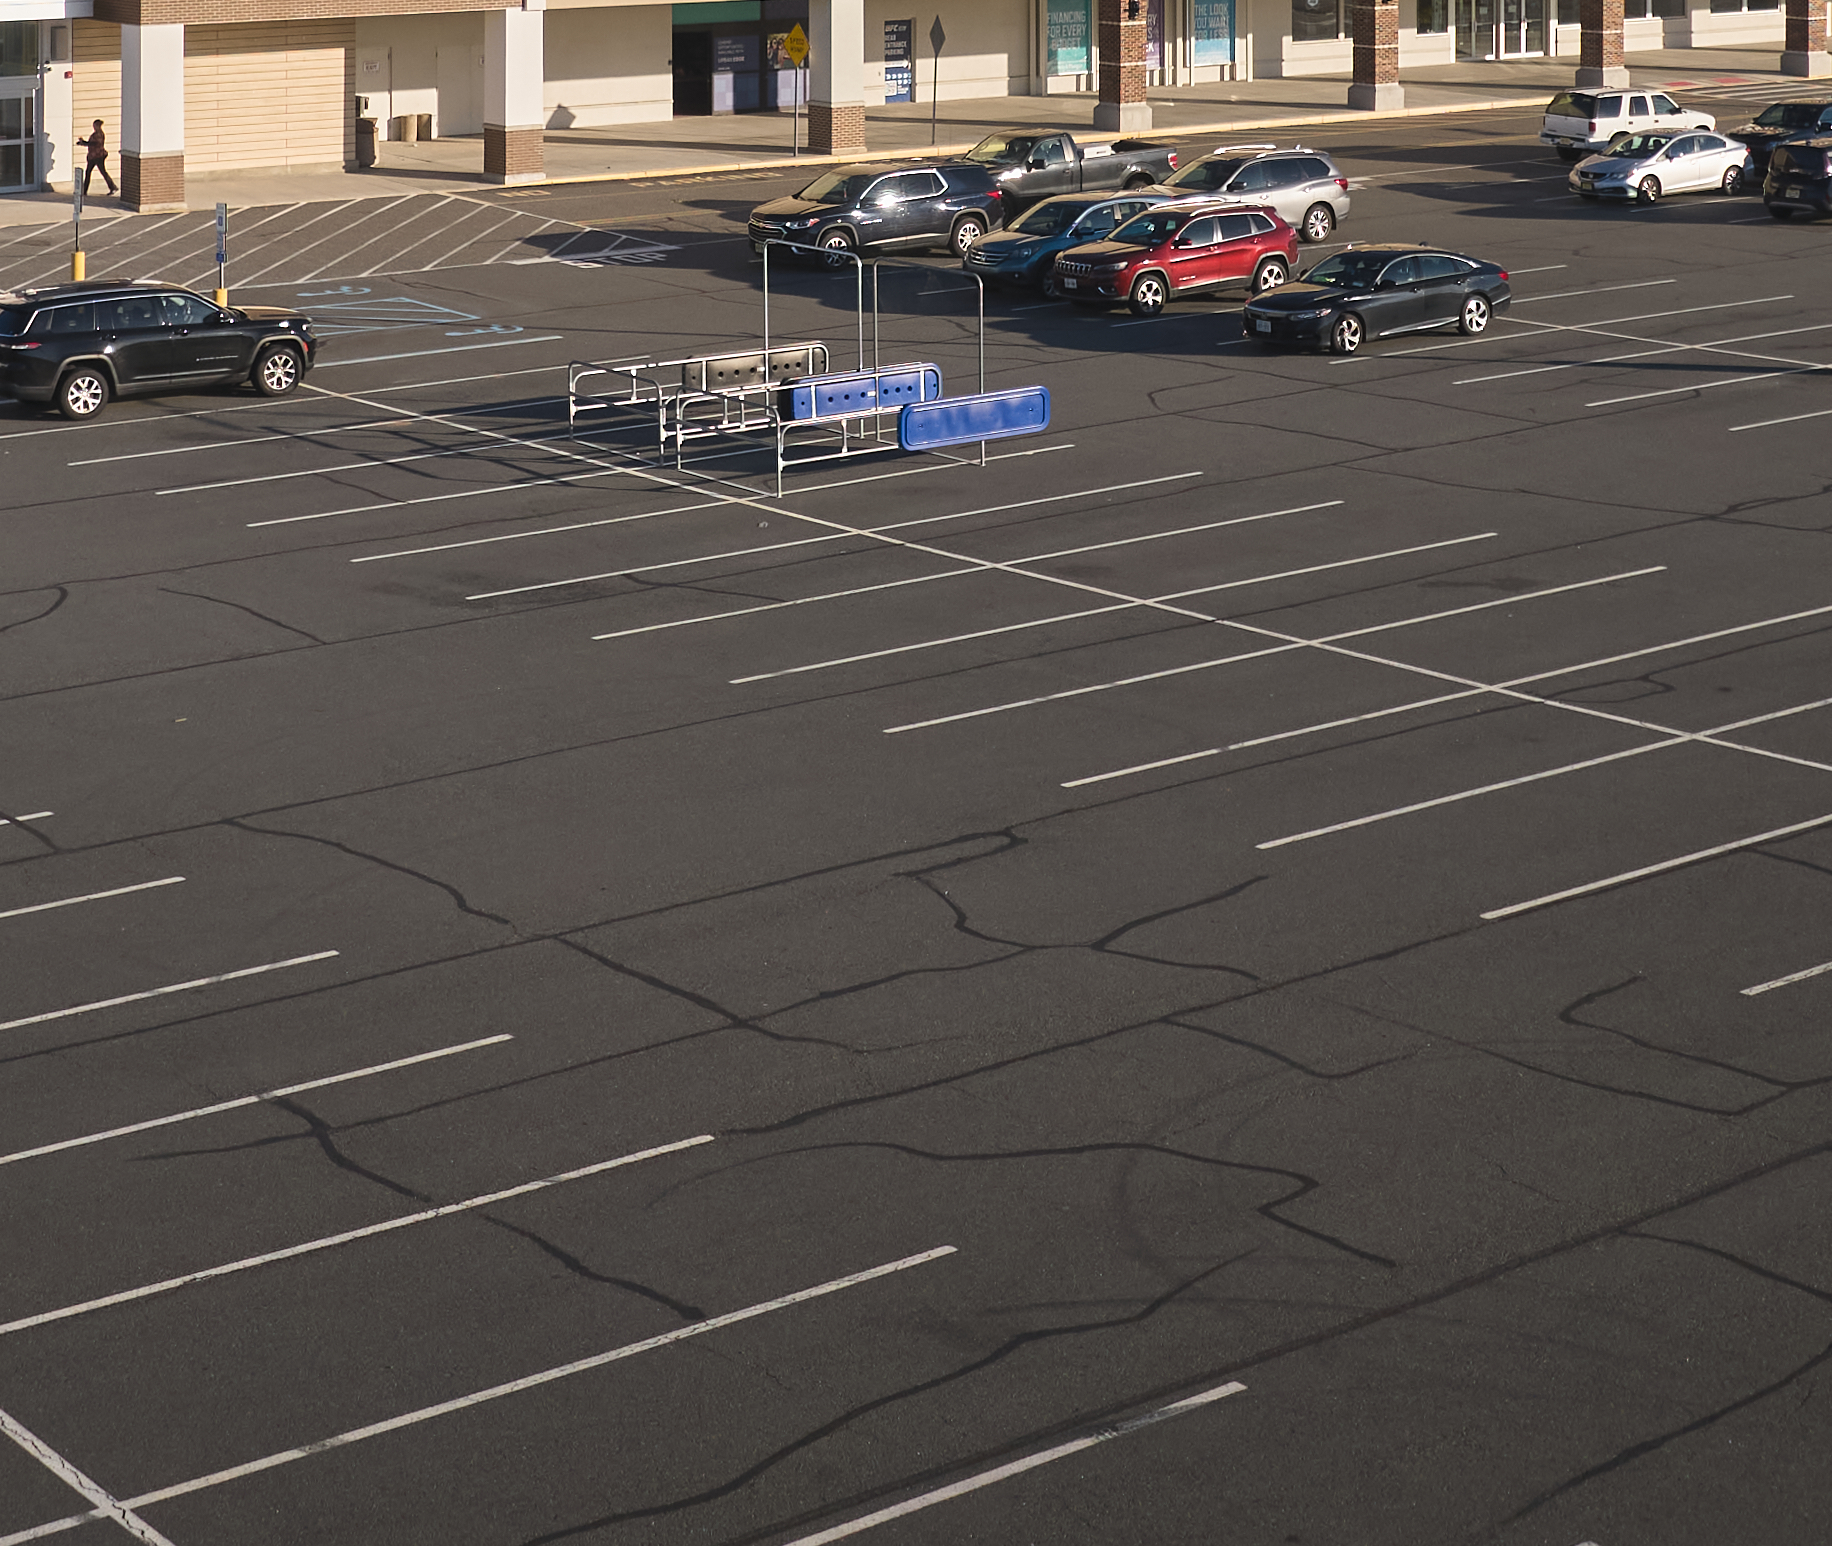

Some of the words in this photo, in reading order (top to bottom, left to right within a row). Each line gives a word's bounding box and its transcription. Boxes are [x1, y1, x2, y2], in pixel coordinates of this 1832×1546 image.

[1195, 4, 1208, 16] THE
[1209, 3, 1229, 15] LOOK
[1047, 11, 1087, 24] FINANCING
[1208, 15, 1230, 28] WANT
[1061, 24, 1087, 37] EVERY
[496, 189, 552, 197] NO
[559, 253, 668, 269] STOP
